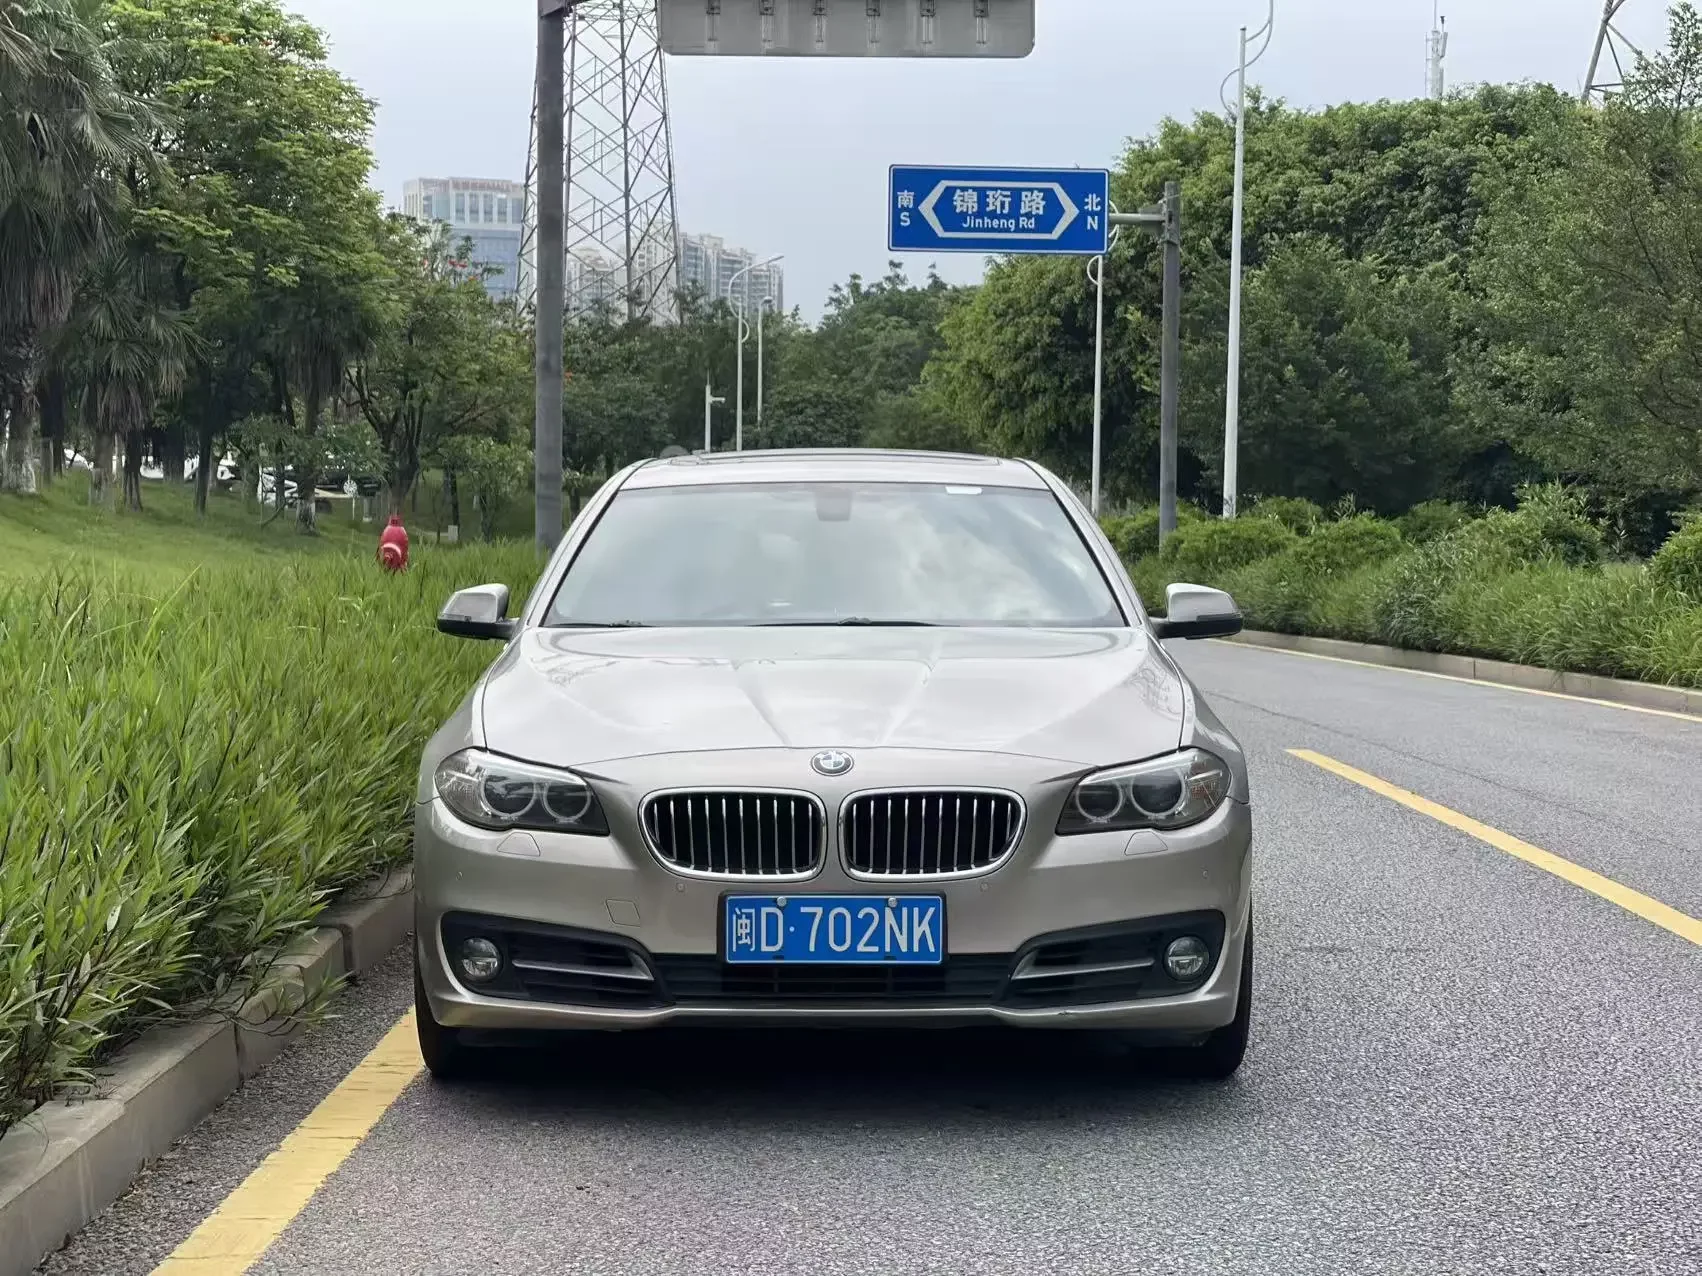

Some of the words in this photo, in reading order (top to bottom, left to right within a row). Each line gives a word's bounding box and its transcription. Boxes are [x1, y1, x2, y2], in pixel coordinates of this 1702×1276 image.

[897, 189, 914, 209] 南
[953, 189, 1046, 215] 锦珩路
[1084, 193, 1101, 212] 北
[900, 212, 911, 227] S
[962, 216, 1015, 231] Jinheng
[1019, 217, 1035, 229] Rd
[1087, 216, 1099, 231] N
[732, 906, 936, 953] 闽D·702NK
